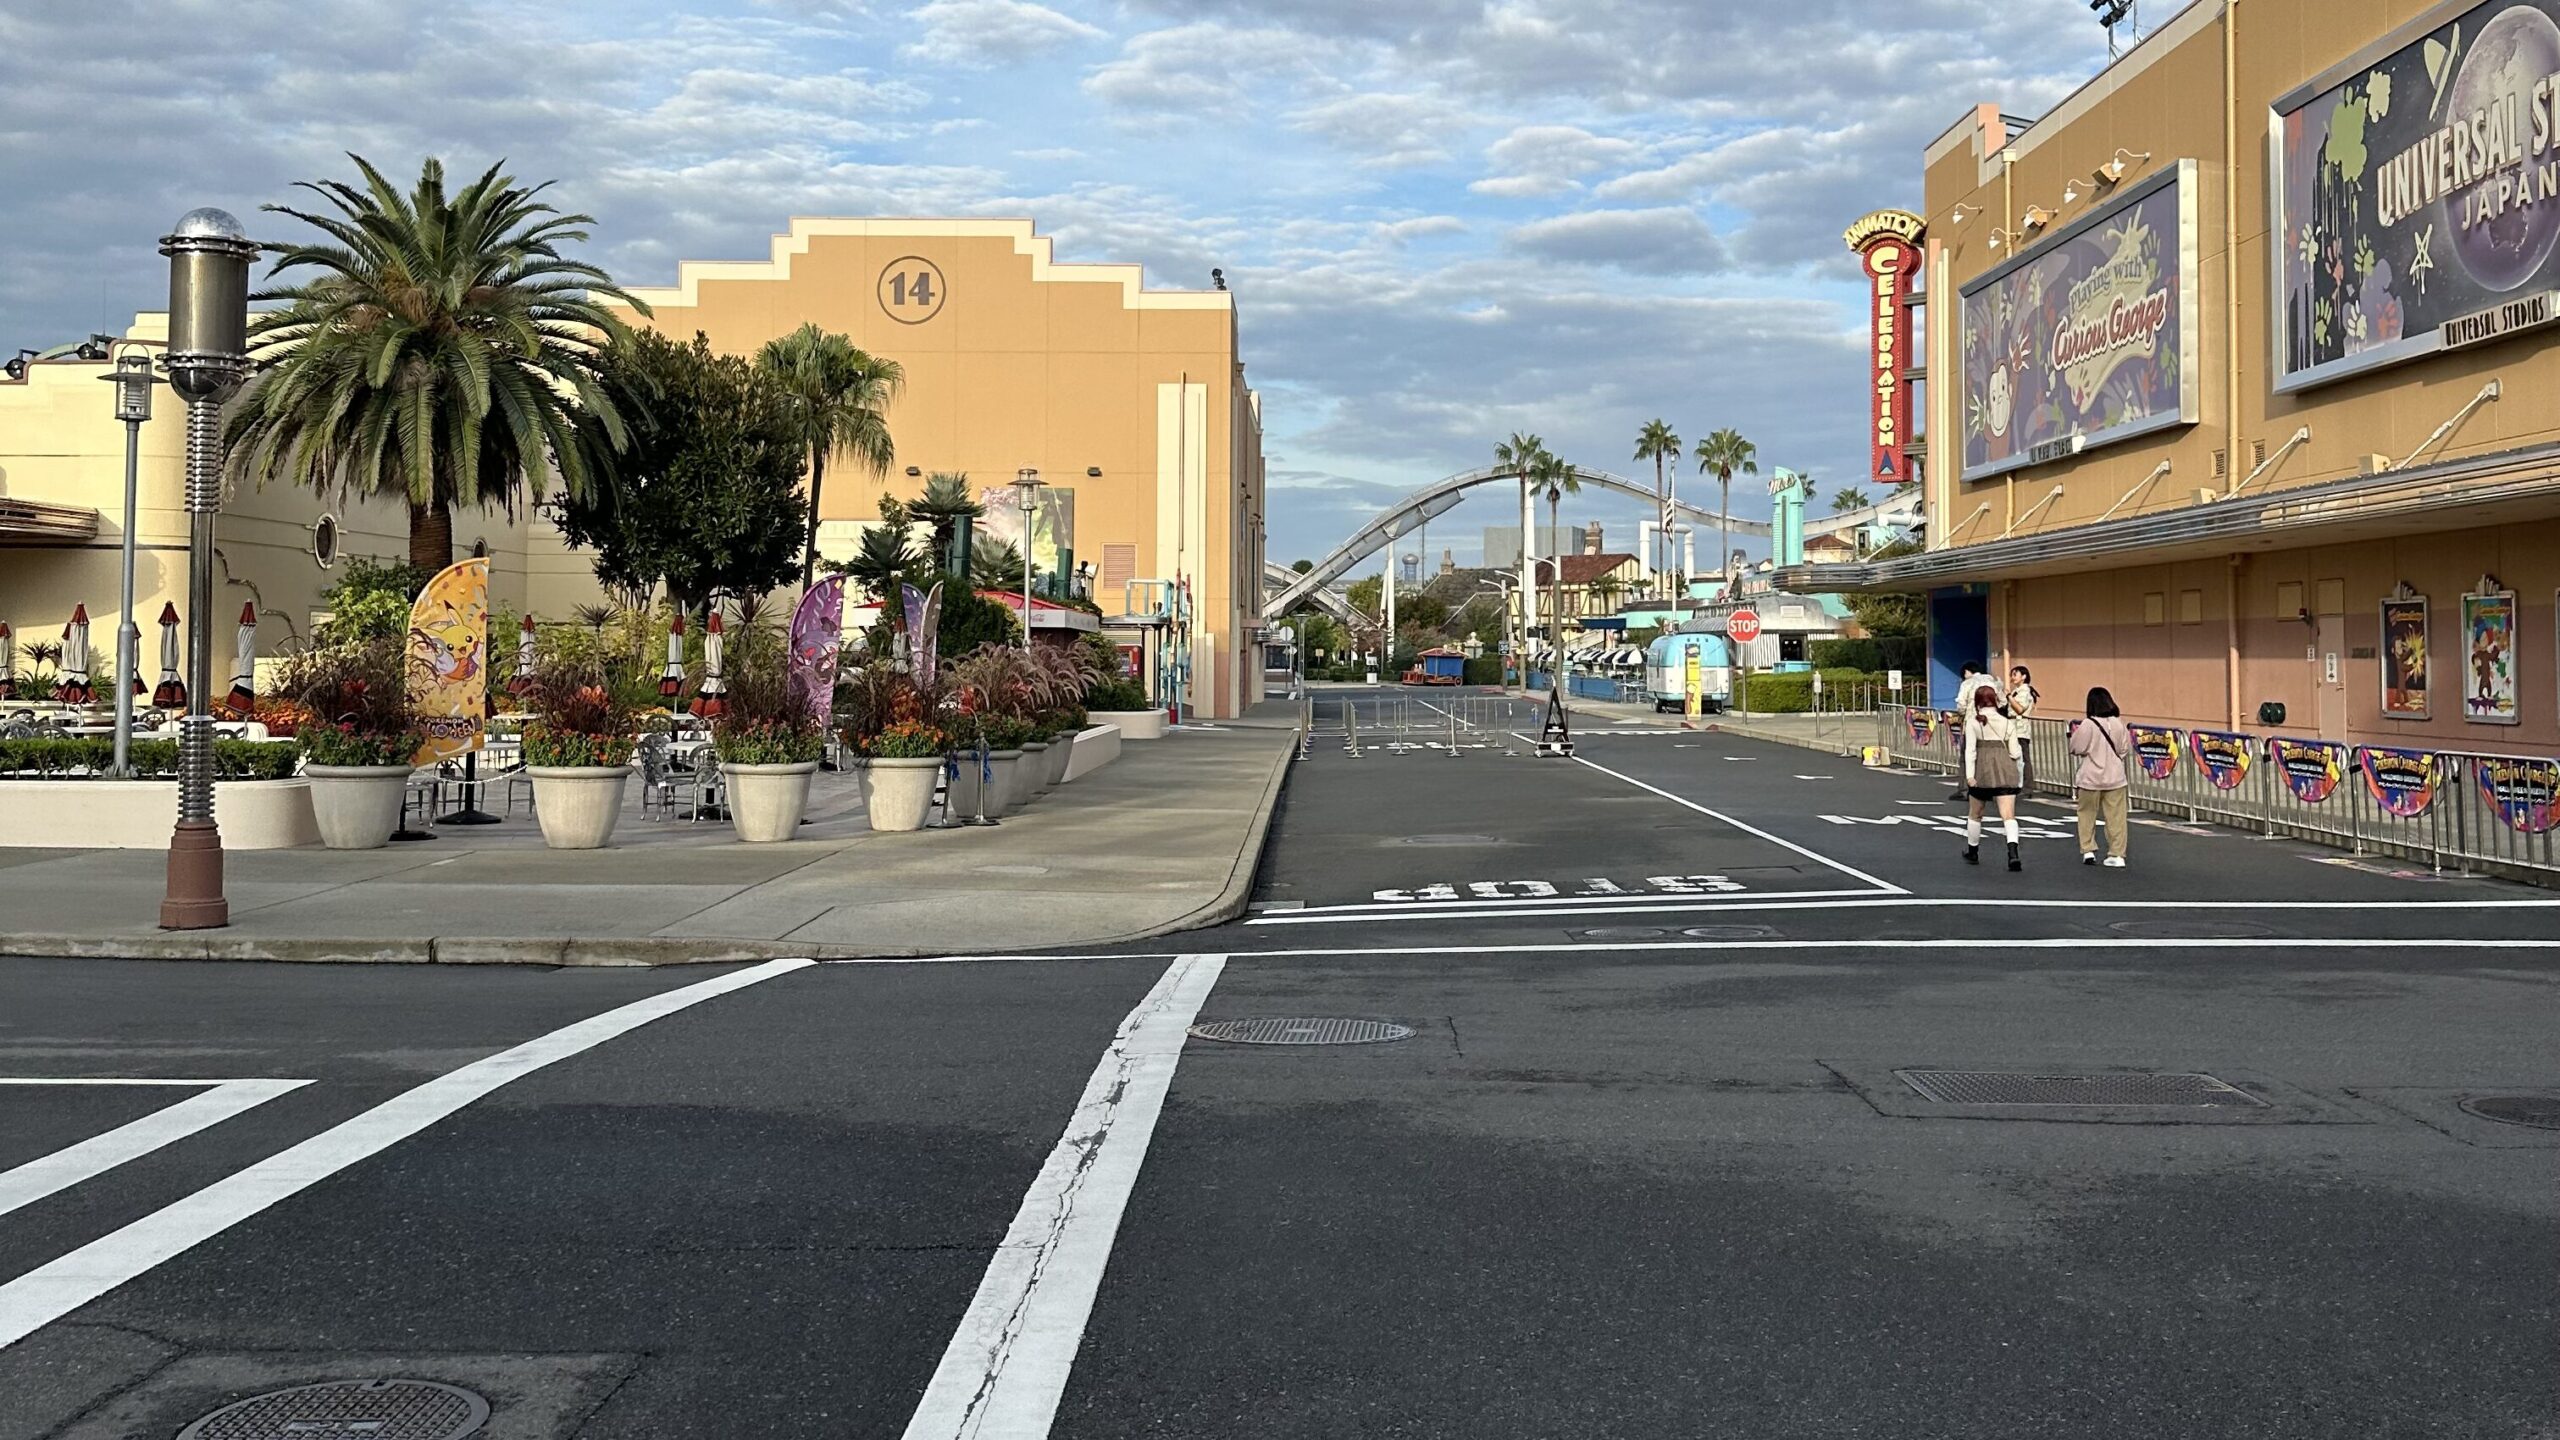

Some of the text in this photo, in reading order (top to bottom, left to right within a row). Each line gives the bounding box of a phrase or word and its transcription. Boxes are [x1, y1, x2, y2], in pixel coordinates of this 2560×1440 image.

[2377, 91, 2523, 227] UNIVERSAL
[2461, 161, 2557, 230] JAPAN
[1844, 212, 1921, 246] ANIMATION
[888, 271, 936, 306] 14
[2069, 257, 2142, 317] Playing with
[1869, 246, 1900, 447] CELEBRATION
[2053, 291, 2166, 370] Curious George
[2445, 296, 2544, 347] UNIVERSAL STUDIOS
[1729, 619, 1759, 634] STOP
